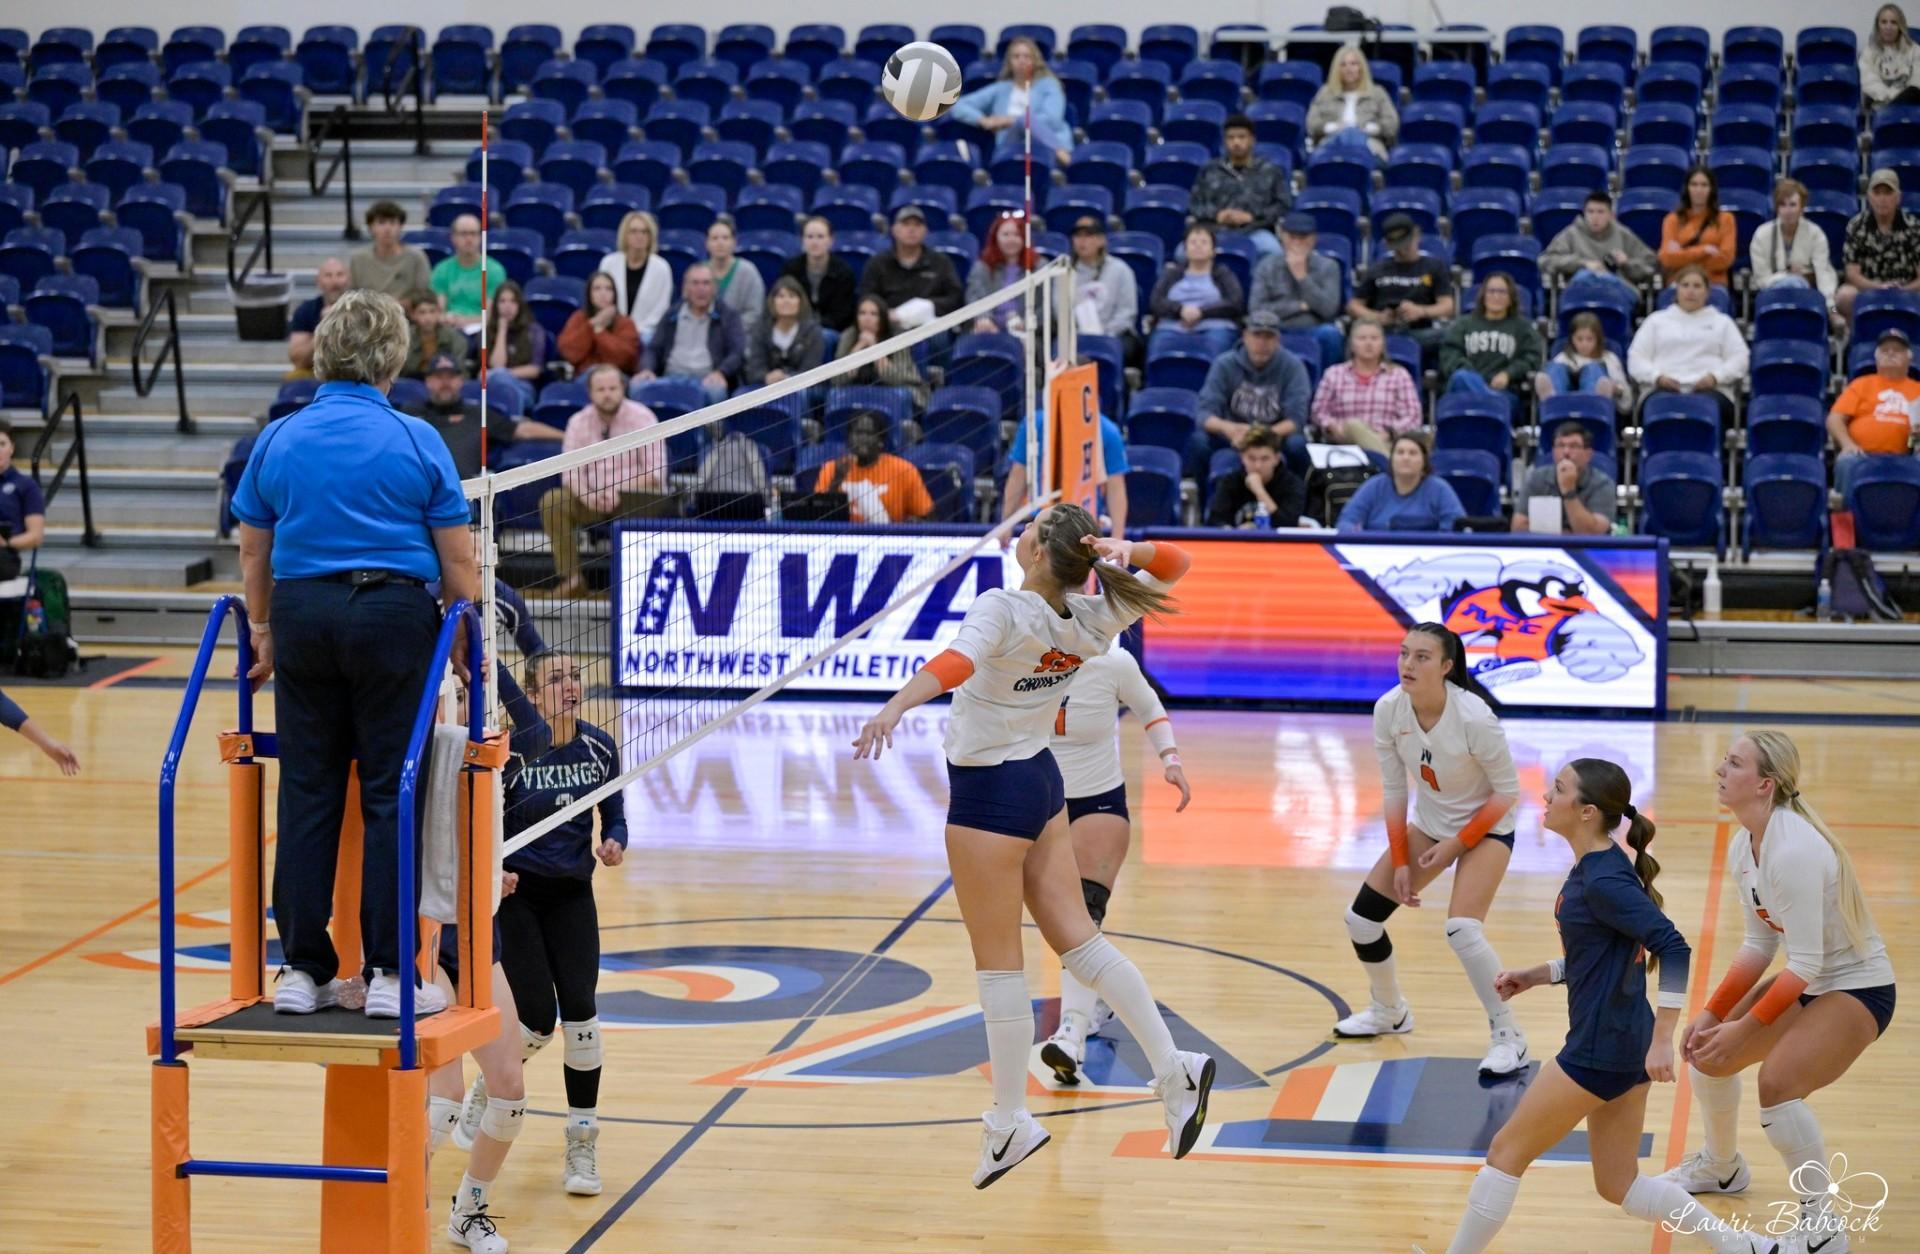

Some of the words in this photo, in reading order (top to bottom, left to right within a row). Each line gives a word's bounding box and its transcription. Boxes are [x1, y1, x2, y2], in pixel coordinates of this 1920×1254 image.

[625, 650, 790, 676] NORTHWEST
[800, 655, 926, 679] ATHLETIC
[520, 761, 600, 790] VIKINGS
